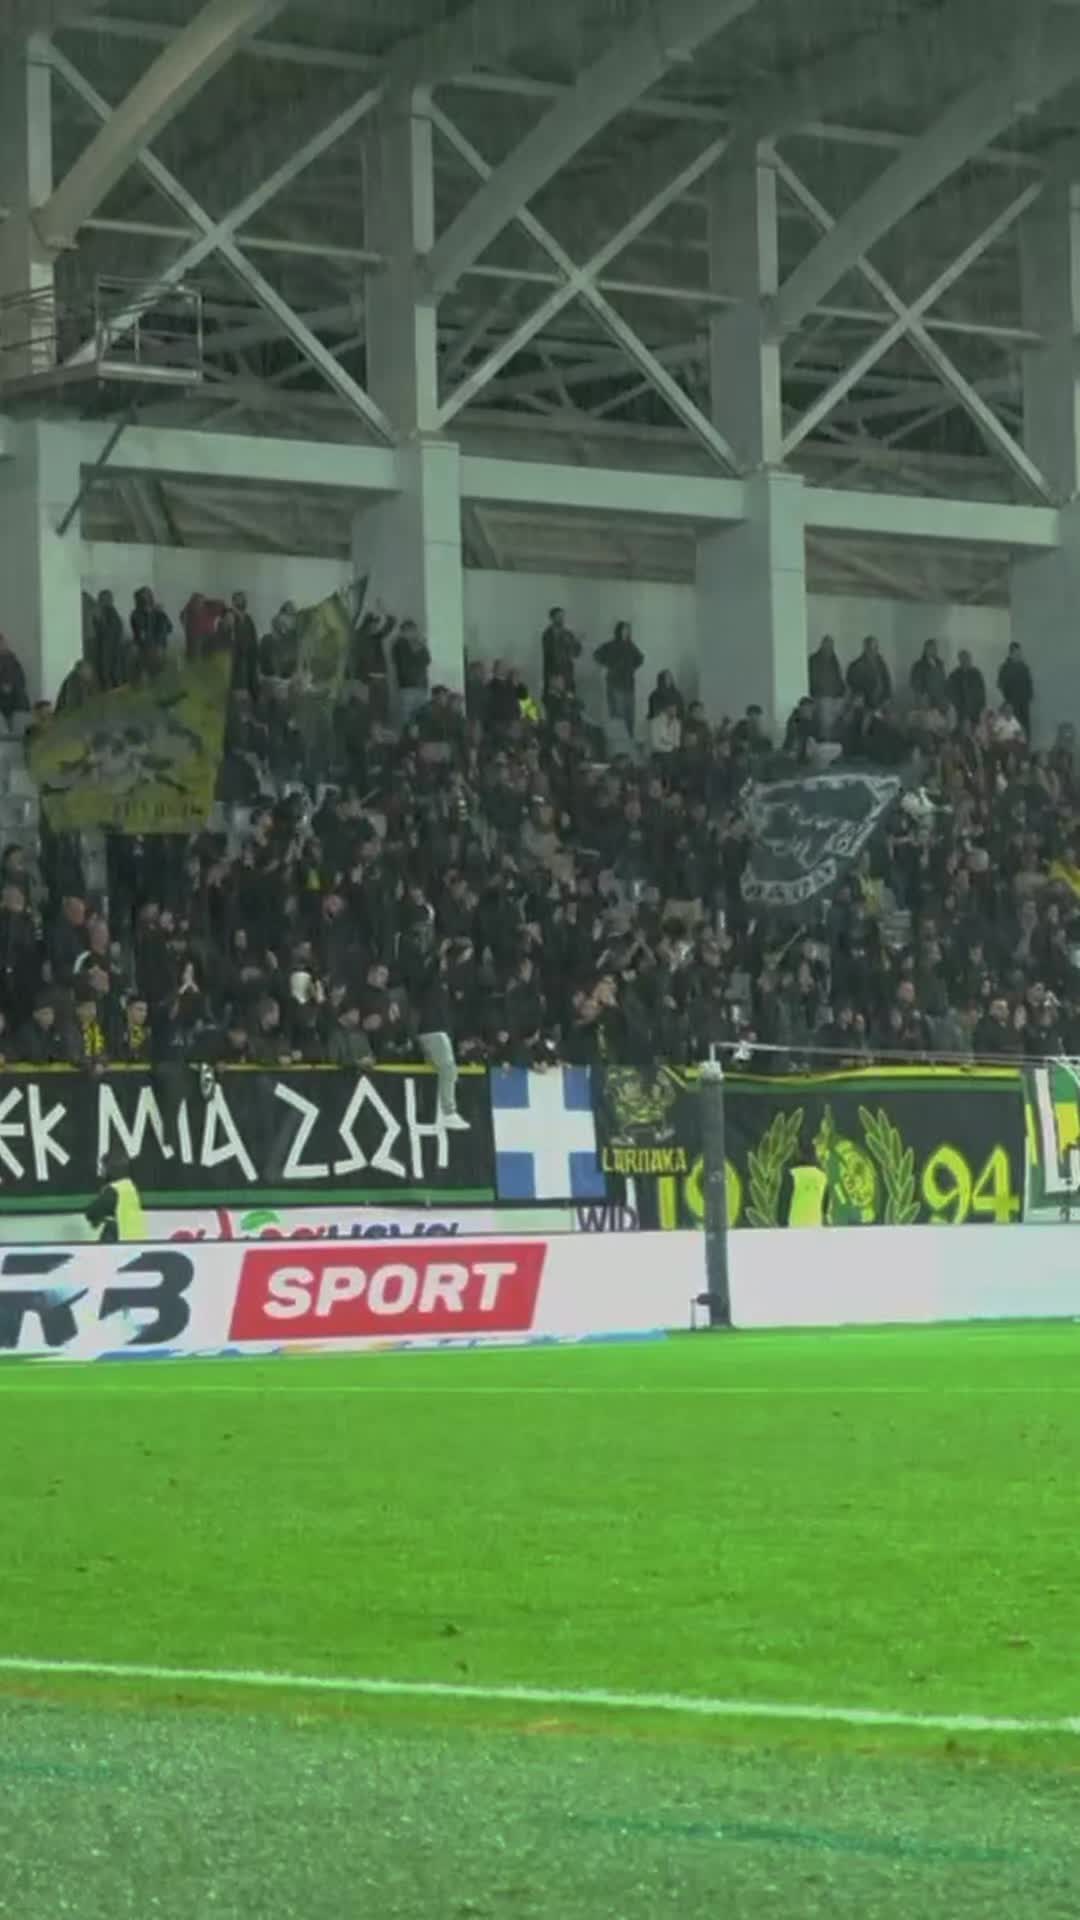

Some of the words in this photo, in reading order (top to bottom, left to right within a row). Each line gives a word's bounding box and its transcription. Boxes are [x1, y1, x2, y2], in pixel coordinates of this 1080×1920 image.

[98, 1083, 259, 1181] ΜΙΑ
[274, 1076, 448, 1179] ΖΩΗ
[924, 1146, 1020, 1224] 94
[263, 1262, 517, 1319] SPORT
